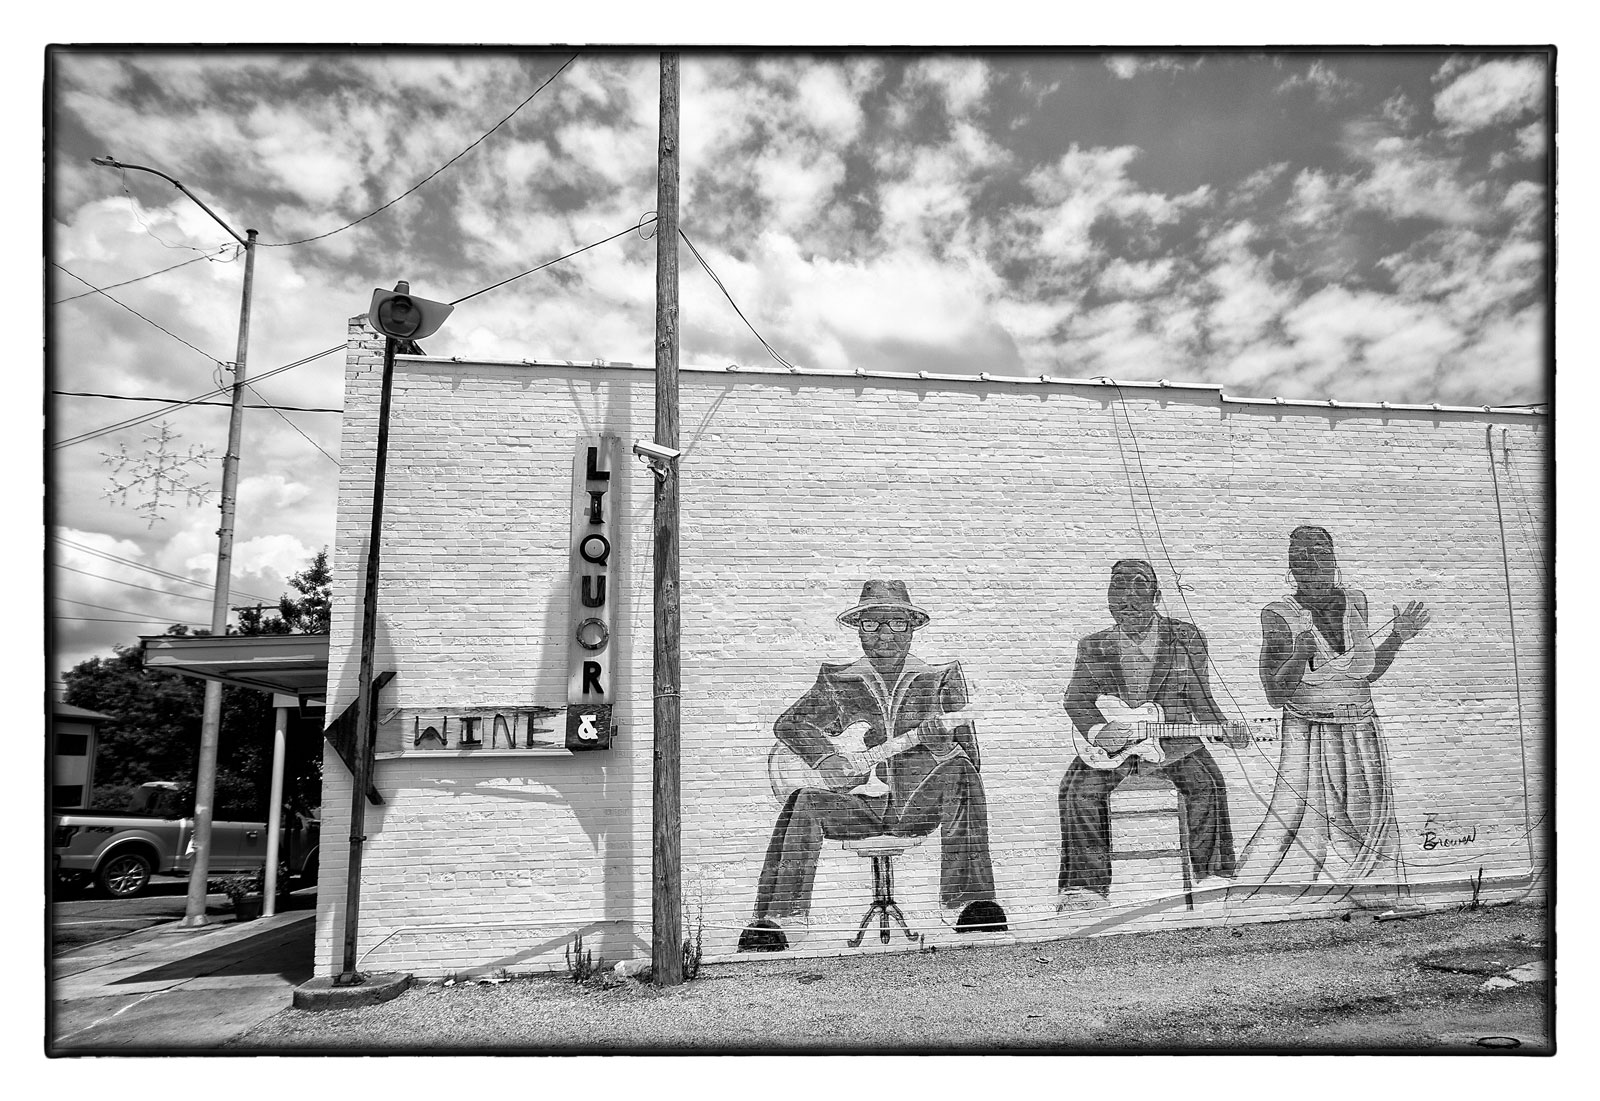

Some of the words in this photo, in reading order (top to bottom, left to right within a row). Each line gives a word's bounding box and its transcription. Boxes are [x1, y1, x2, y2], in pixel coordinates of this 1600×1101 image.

[576, 446, 611, 695] LIQUOR
[414, 712, 555, 749] WINE
[577, 714, 599, 741] &
